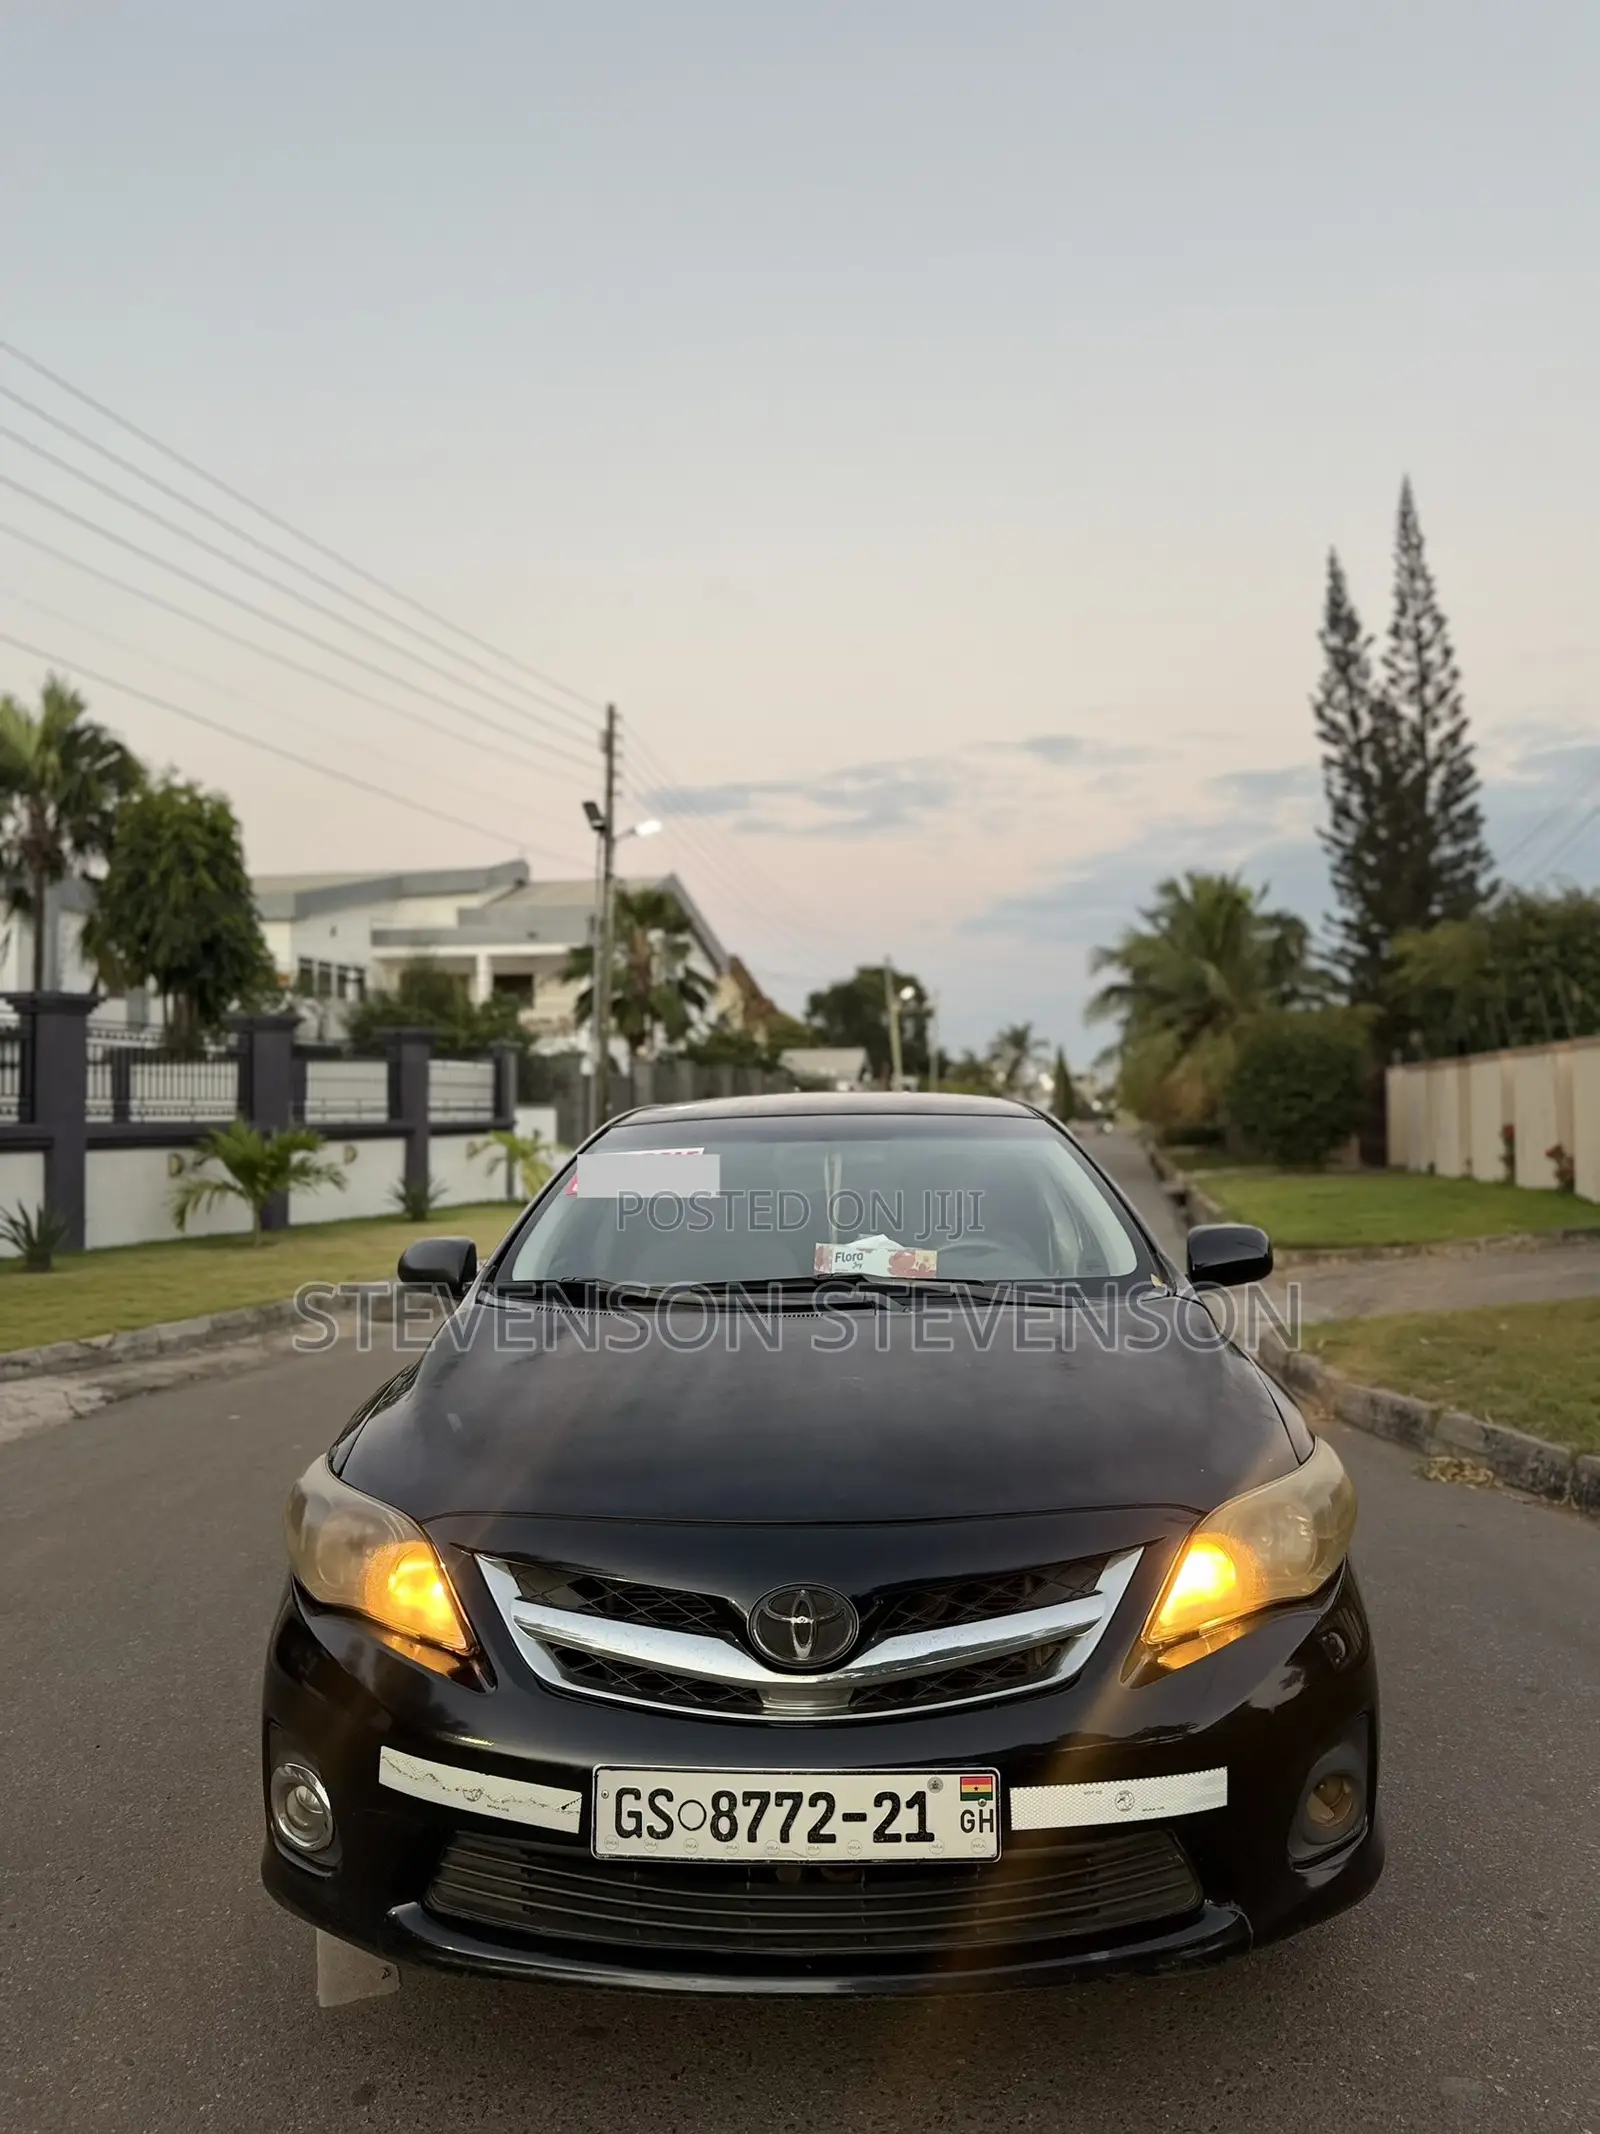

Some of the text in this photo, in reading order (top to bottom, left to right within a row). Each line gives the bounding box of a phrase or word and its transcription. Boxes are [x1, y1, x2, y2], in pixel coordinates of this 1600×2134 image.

[834, 1251, 864, 1263] Flora
[614, 1786, 936, 1844] GS 8772-21
[960, 1808, 994, 1834] GH
